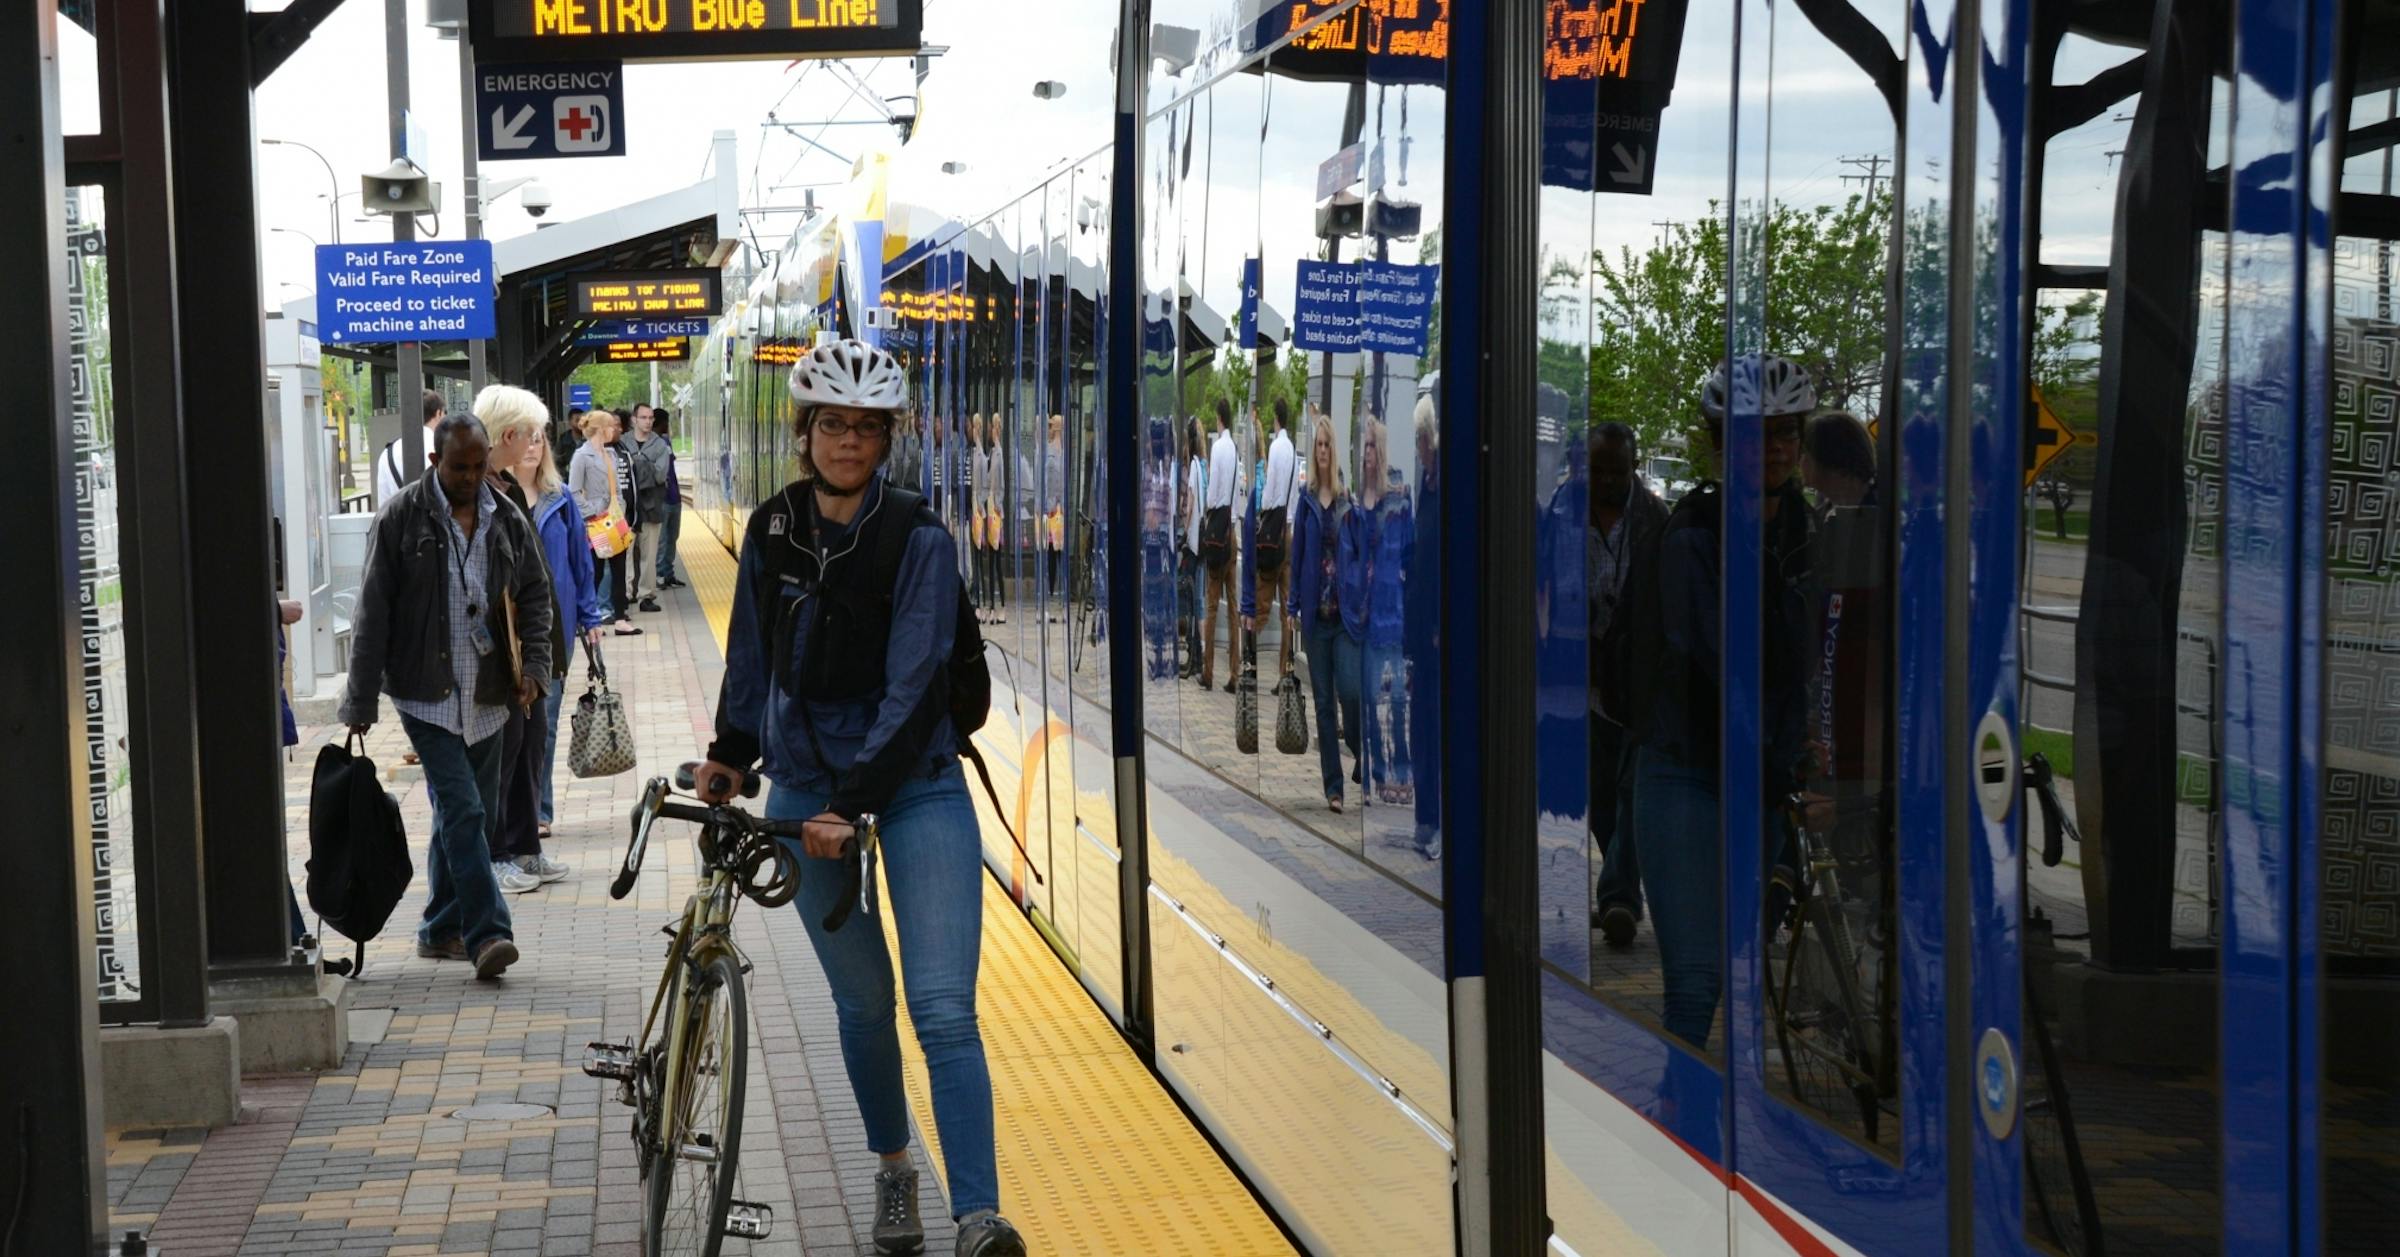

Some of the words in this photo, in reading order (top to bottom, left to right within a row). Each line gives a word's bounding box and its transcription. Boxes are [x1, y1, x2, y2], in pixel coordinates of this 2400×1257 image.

[693, 0, 765, 31] Blue
[791, 0, 877, 28] Line!
[484, 72, 613, 92] EMERGENCY
[346, 252, 378, 266] Paid
[384, 251, 417, 265] Fare
[423, 250, 464, 264] Zone
[328, 272, 366, 287] Valid
[372, 271, 405, 286] Fare
[411, 269, 481, 288] Required
[337, 297, 401, 313] Proceed
[408, 299, 425, 311] to
[431, 296, 476, 310] ticket
[349, 317, 414, 332] machine
[419, 315, 465, 330] ahead
[646, 321, 700, 334] TICKETS
